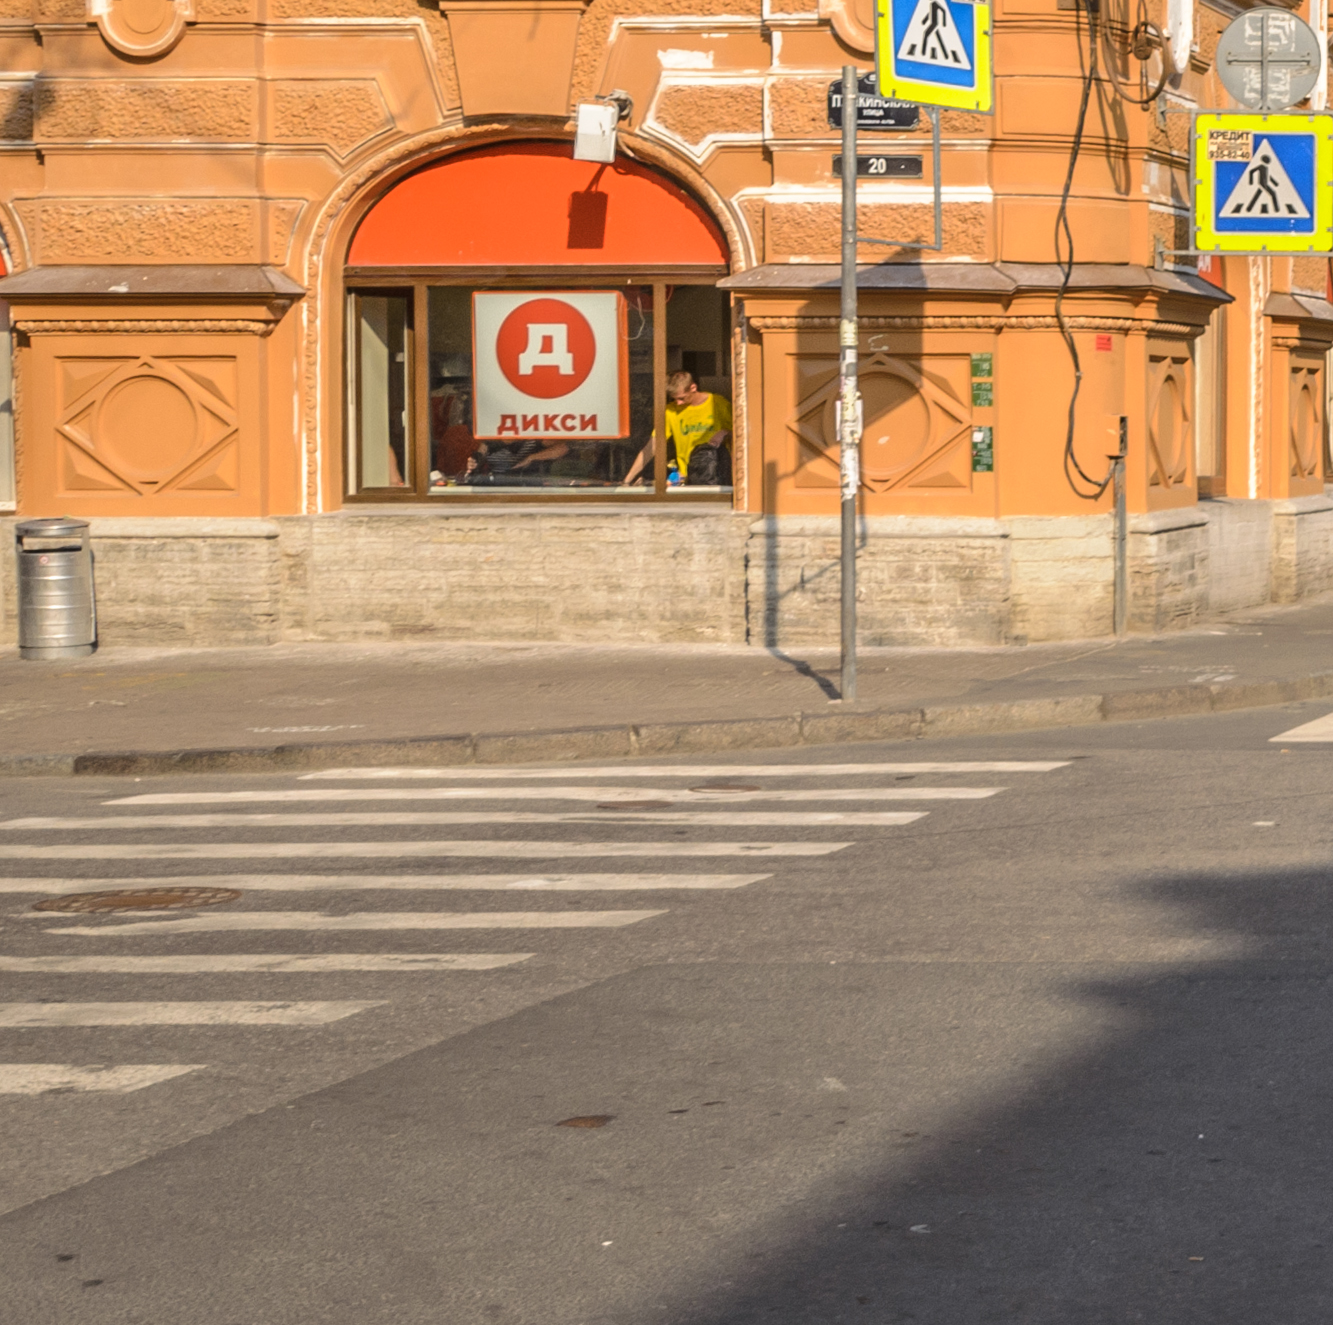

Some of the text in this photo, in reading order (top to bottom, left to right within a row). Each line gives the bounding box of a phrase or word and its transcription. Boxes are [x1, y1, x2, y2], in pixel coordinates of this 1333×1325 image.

[1209, 131, 1251, 141] КРЕДИТ
[867, 158, 887, 174] 20
[518, 323, 575, 375] Д
